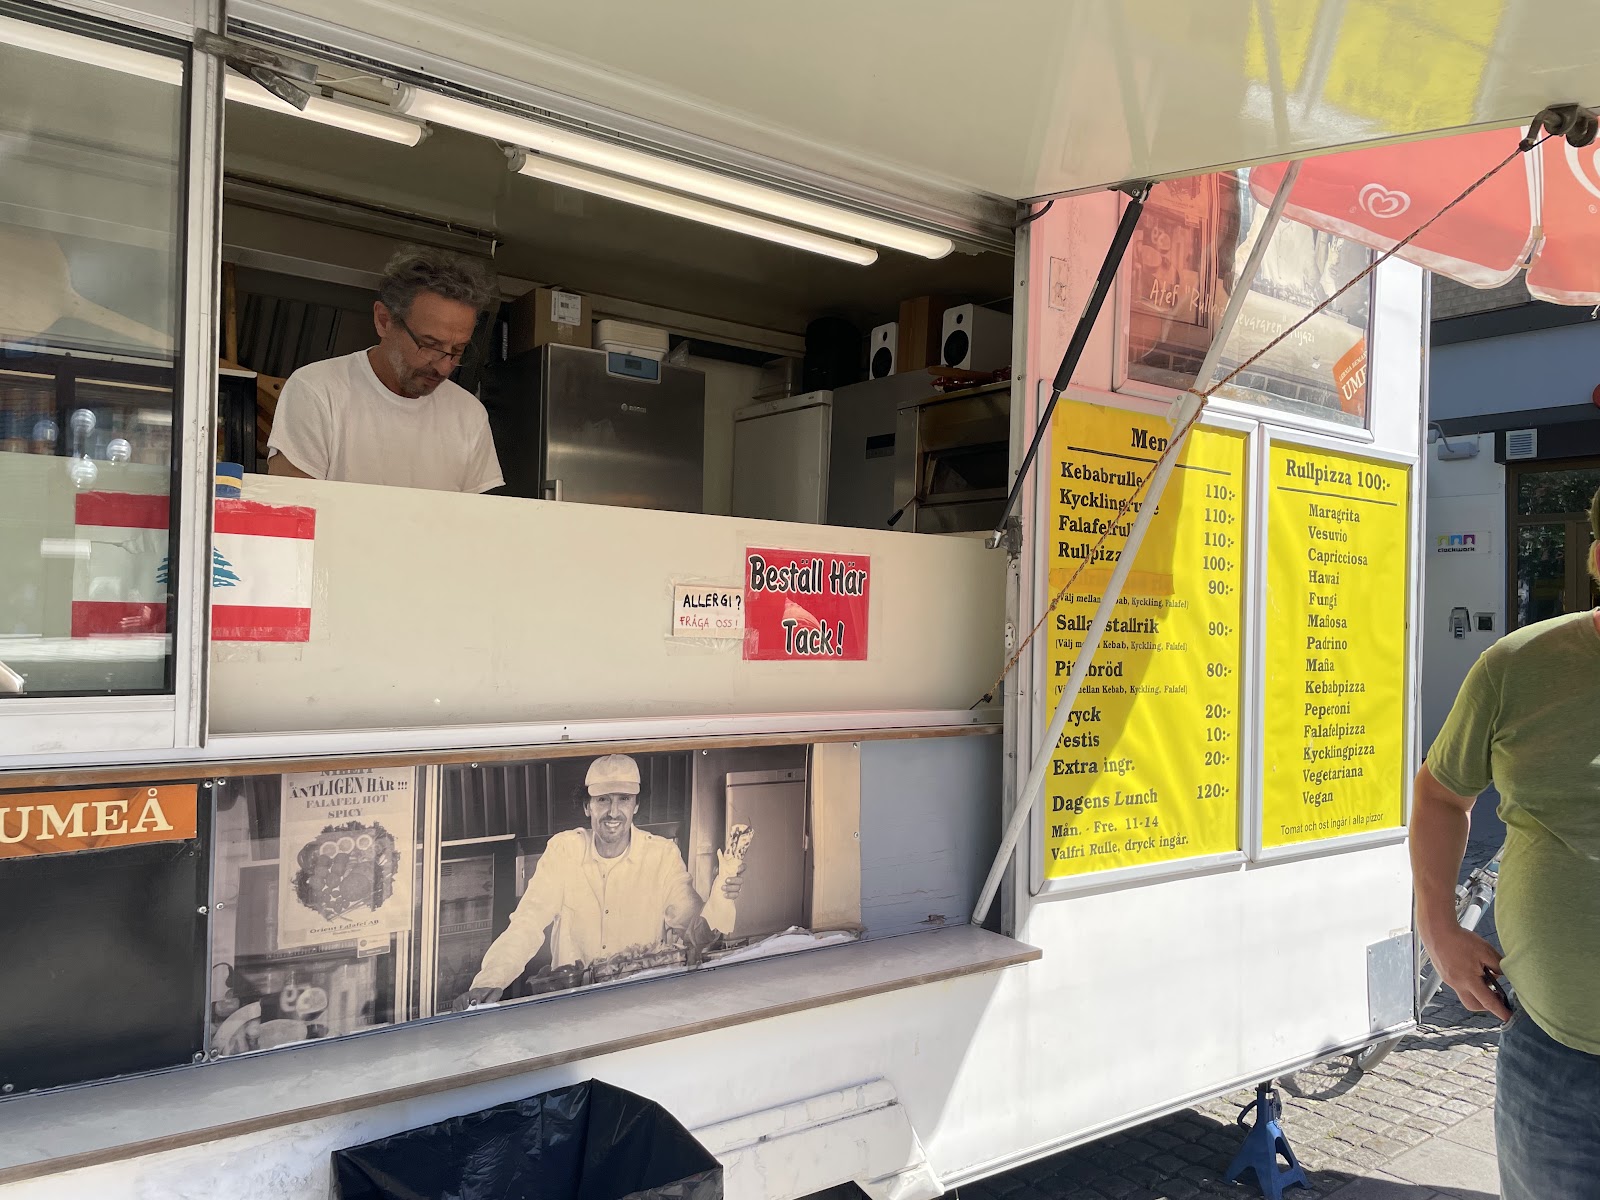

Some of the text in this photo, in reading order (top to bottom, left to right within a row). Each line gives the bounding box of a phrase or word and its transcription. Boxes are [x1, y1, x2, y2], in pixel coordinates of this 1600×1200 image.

[1150, 279, 1179, 306] Atef
[1131, 428, 1168, 452] Men
[1061, 462, 1235, 501] Kebabrulle 110:-
[1286, 458, 1390, 492] Rullpizza 100:-
[1060, 488, 1235, 524] Kycklingru 110:-
[1308, 503, 1360, 524] Maragrita
[1058, 514, 1234, 548] Falafelrul 110:-
[1308, 526, 1348, 543] Vesuvio
[1058, 541, 1234, 572] Rullpizz 100:-
[1308, 548, 1368, 566] Capricciosa
[748, 554, 867, 596] Beställ Här
[1308, 570, 1340, 585] Hawai
[1058, 592, 1074, 604] Välj
[1076, 594, 1101, 604] mellan
[1208, 580, 1234, 596] 90:-
[1308, 592, 1337, 610] Fungi
[679, 614, 710, 628] FRÅGA
[1056, 614, 1233, 636] Sallastallrik 90:-
[1307, 614, 1348, 629] Mafiosa
[1102, 640, 1129, 650] Kebab,
[1306, 636, 1348, 650] Padrino
[1055, 660, 1232, 678] Pibröd 80:-
[1306, 658, 1335, 672] Mafia
[1102, 685, 1127, 695] Kebab,
[1305, 680, 1365, 697] Kebabpizza
[1055, 704, 1231, 727] ryck 20:-
[1304, 701, 1350, 720] Peperoni
[1055, 726, 1231, 749] Festis 10:-
[1304, 723, 1366, 740] Falafelpizza
[1053, 750, 1230, 776] Extra ingr. 20:-
[1303, 744, 1375, 763] Kycklingpizza
[1302, 765, 1364, 786] Vegetariana
[290, 776, 364, 798] ÄNTLIGEN
[367, 776, 394, 792] HÄR
[306, 794, 388, 808] FALAFEL HOT
[1052, 782, 1230, 815] Dagens Lunch 120:-
[1302, 790, 1334, 808] Vegan
[0, 788, 174, 844] UMEÅ
[328, 808, 362, 818] SPICY
[1052, 822, 1082, 838] Mån.
[1094, 820, 1117, 833] Fre.
[1126, 816, 1158, 830] 11-14
[1280, 823, 1303, 836] Tomat
[1304, 820, 1317, 832] och
[1318, 818, 1329, 830] ost
[1330, 816, 1348, 830] ingår
[1352, 814, 1365, 825] alla
[1365, 812, 1384, 826] pizzor
[1051, 832, 1189, 860] Valfri Rulle, dryck ingår.
